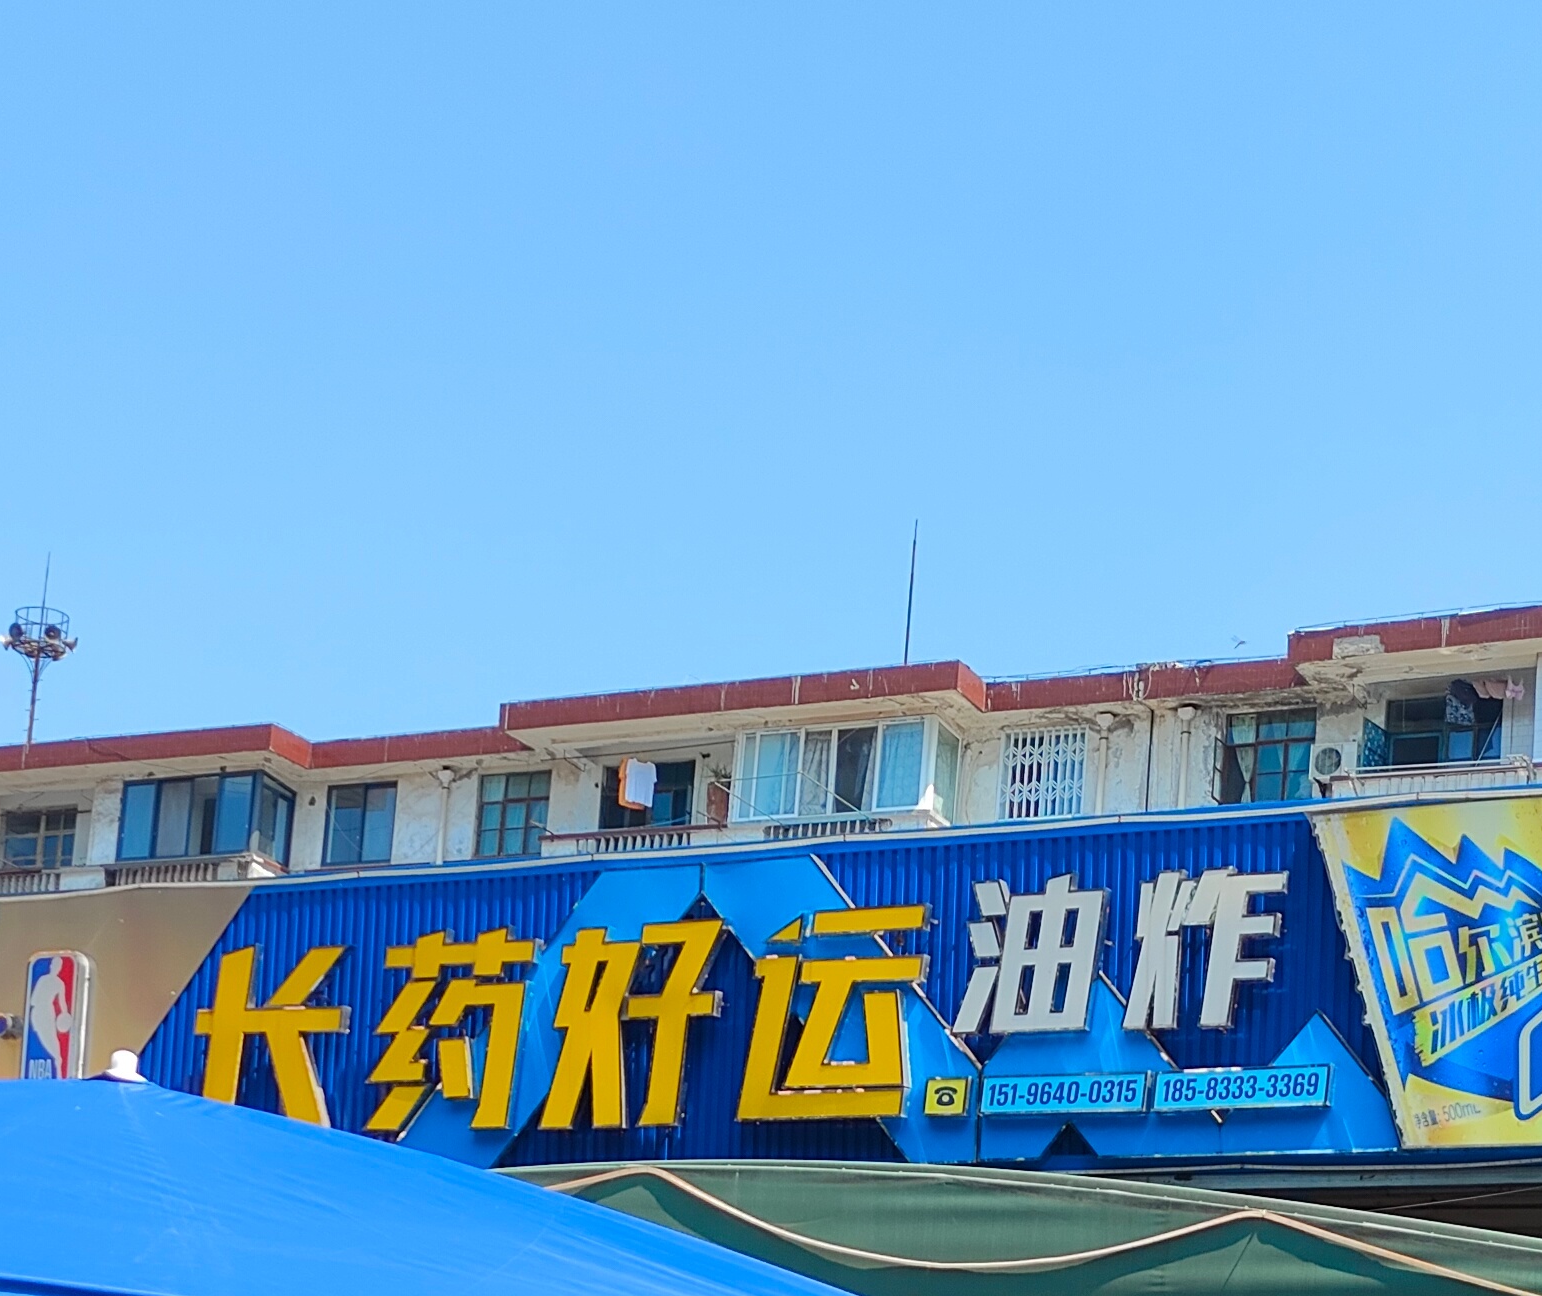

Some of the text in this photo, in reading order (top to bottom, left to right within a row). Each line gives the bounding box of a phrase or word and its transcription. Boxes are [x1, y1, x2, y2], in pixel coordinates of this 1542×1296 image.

[194, 867, 1289, 1131] 长药好运 油炸
[28, 1057, 52, 1080] NBA
[988, 1072, 1320, 1107] 151-9640-0315 185-8333-3369
